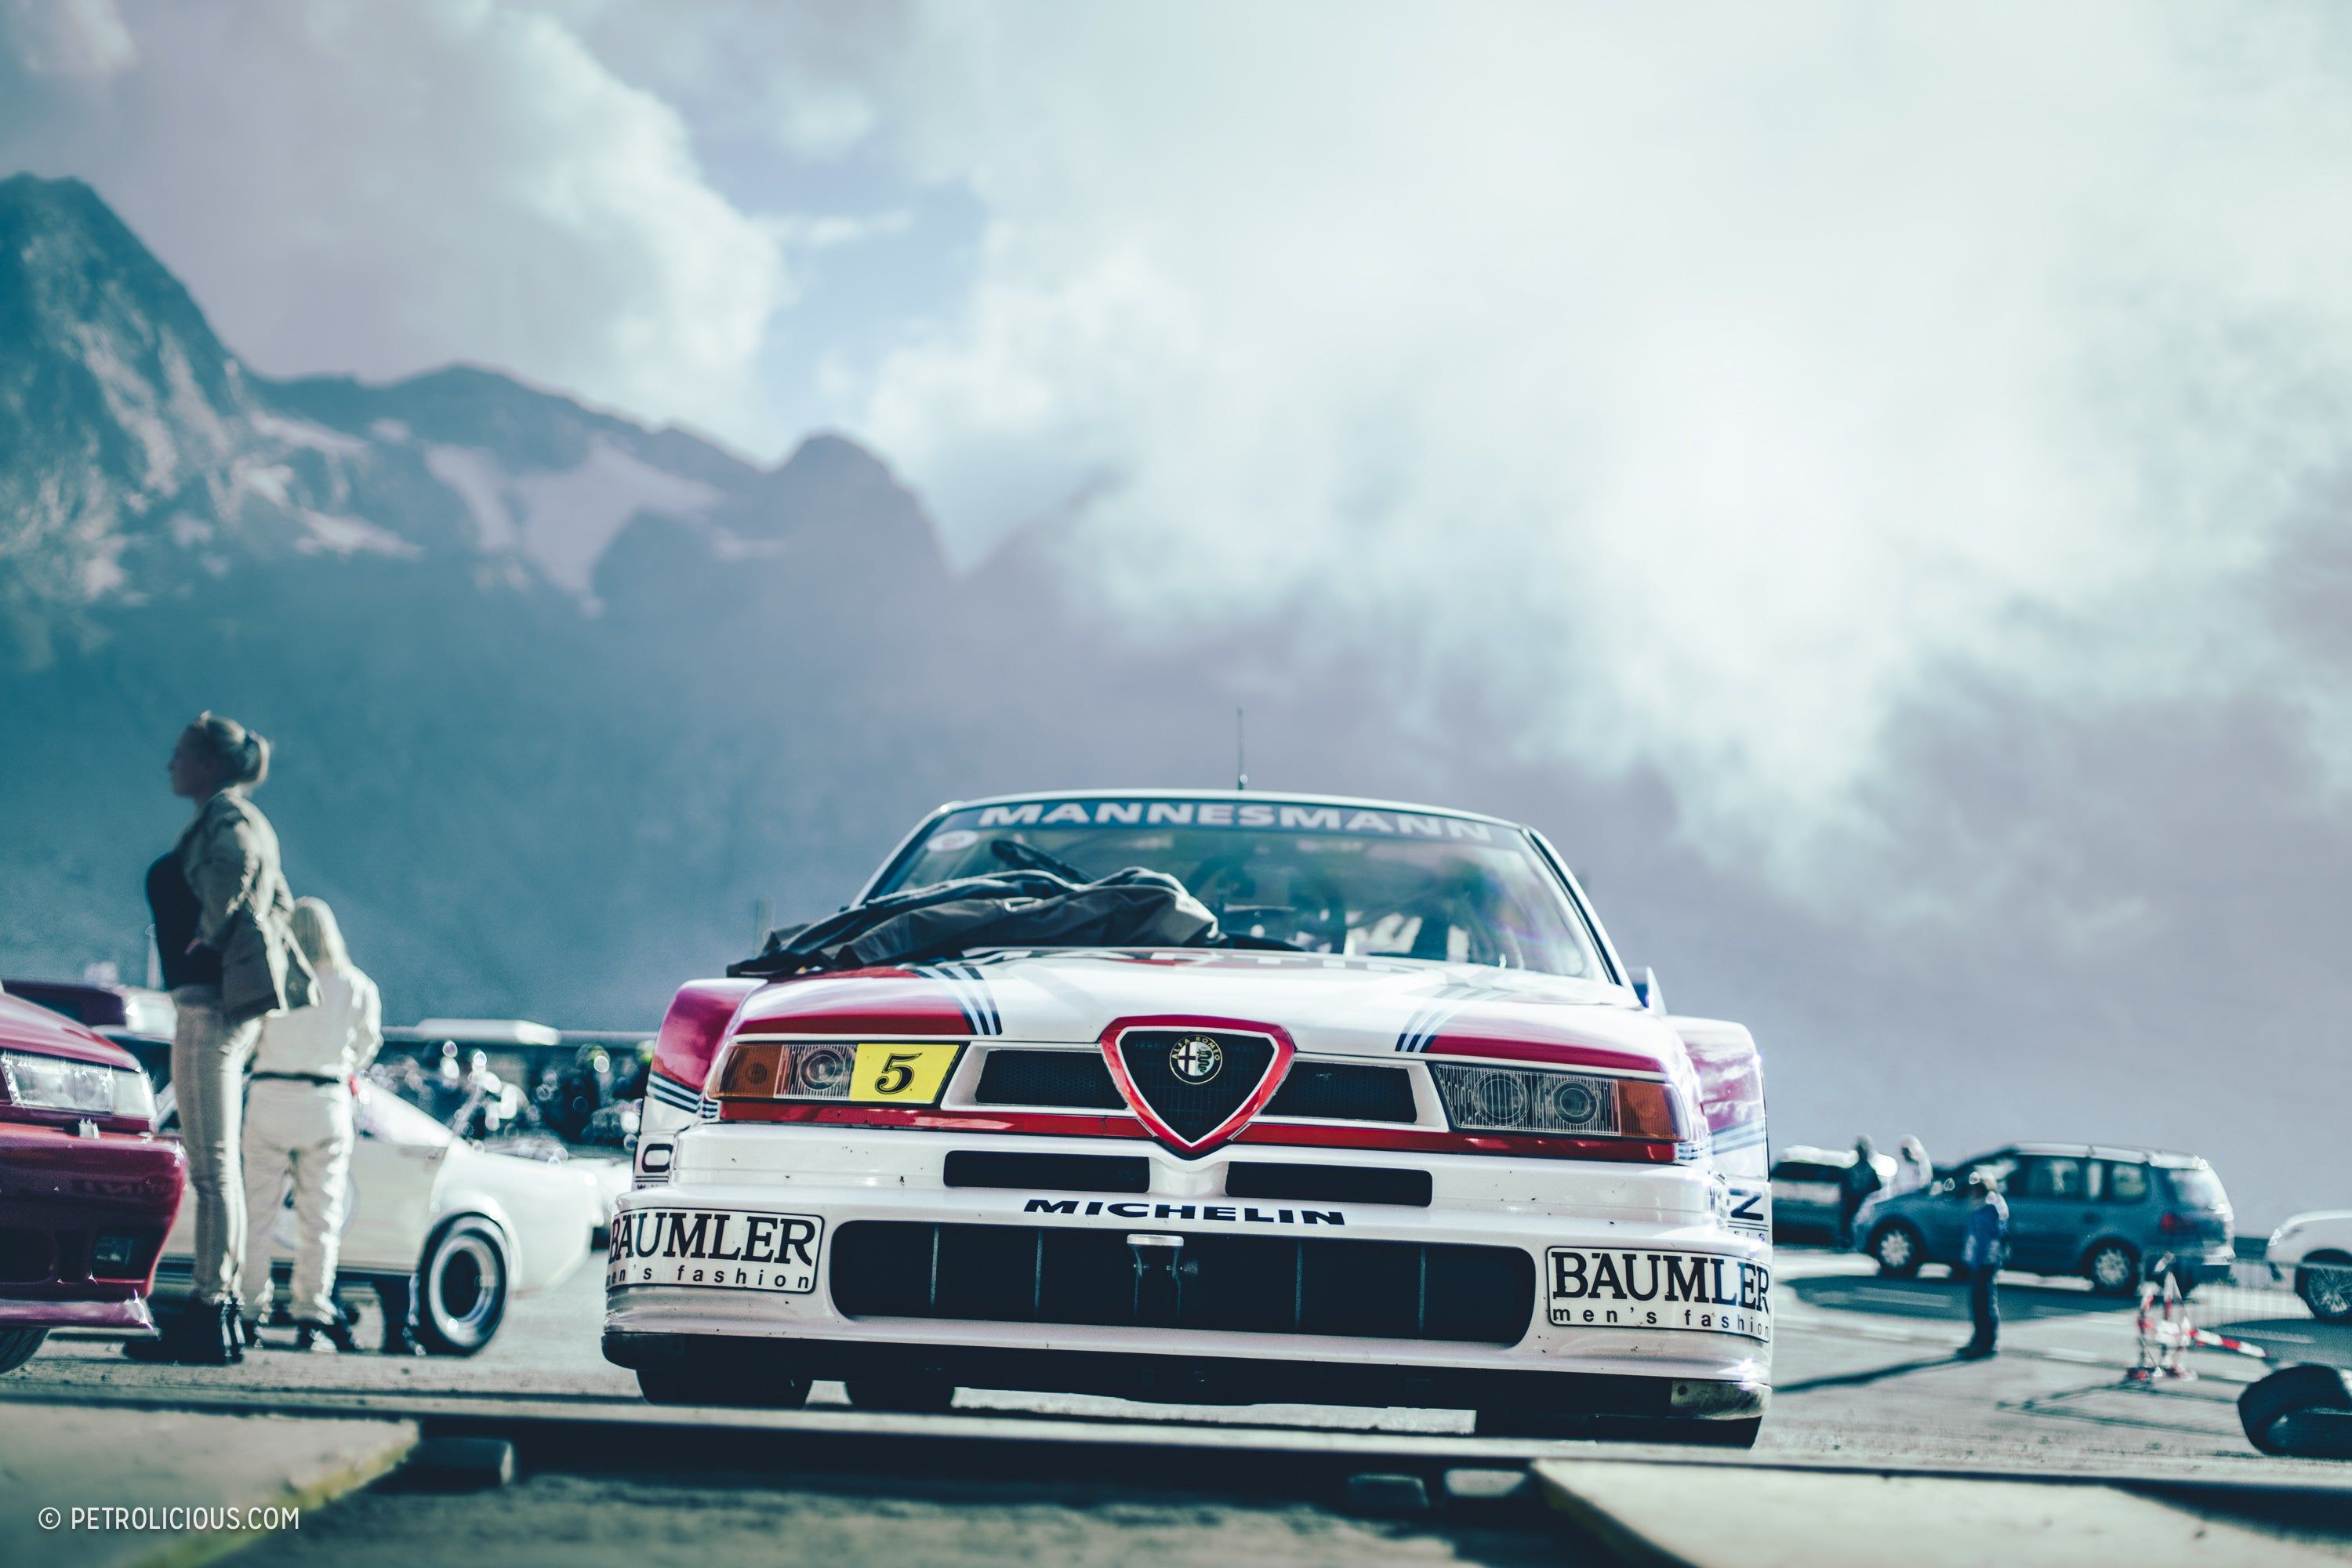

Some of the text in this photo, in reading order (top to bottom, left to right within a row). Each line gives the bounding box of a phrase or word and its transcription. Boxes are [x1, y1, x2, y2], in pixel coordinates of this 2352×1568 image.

[978, 802, 1492, 841] MANNESMANN
[1171, 1036, 1221, 1061] ALFA ROMEO
[874, 1052, 923, 1094] 5
[1023, 1199, 1345, 1225] MICHELIN
[677, 1264, 810, 1289] fashion
[1553, 1306, 1769, 1338] men's fashion
